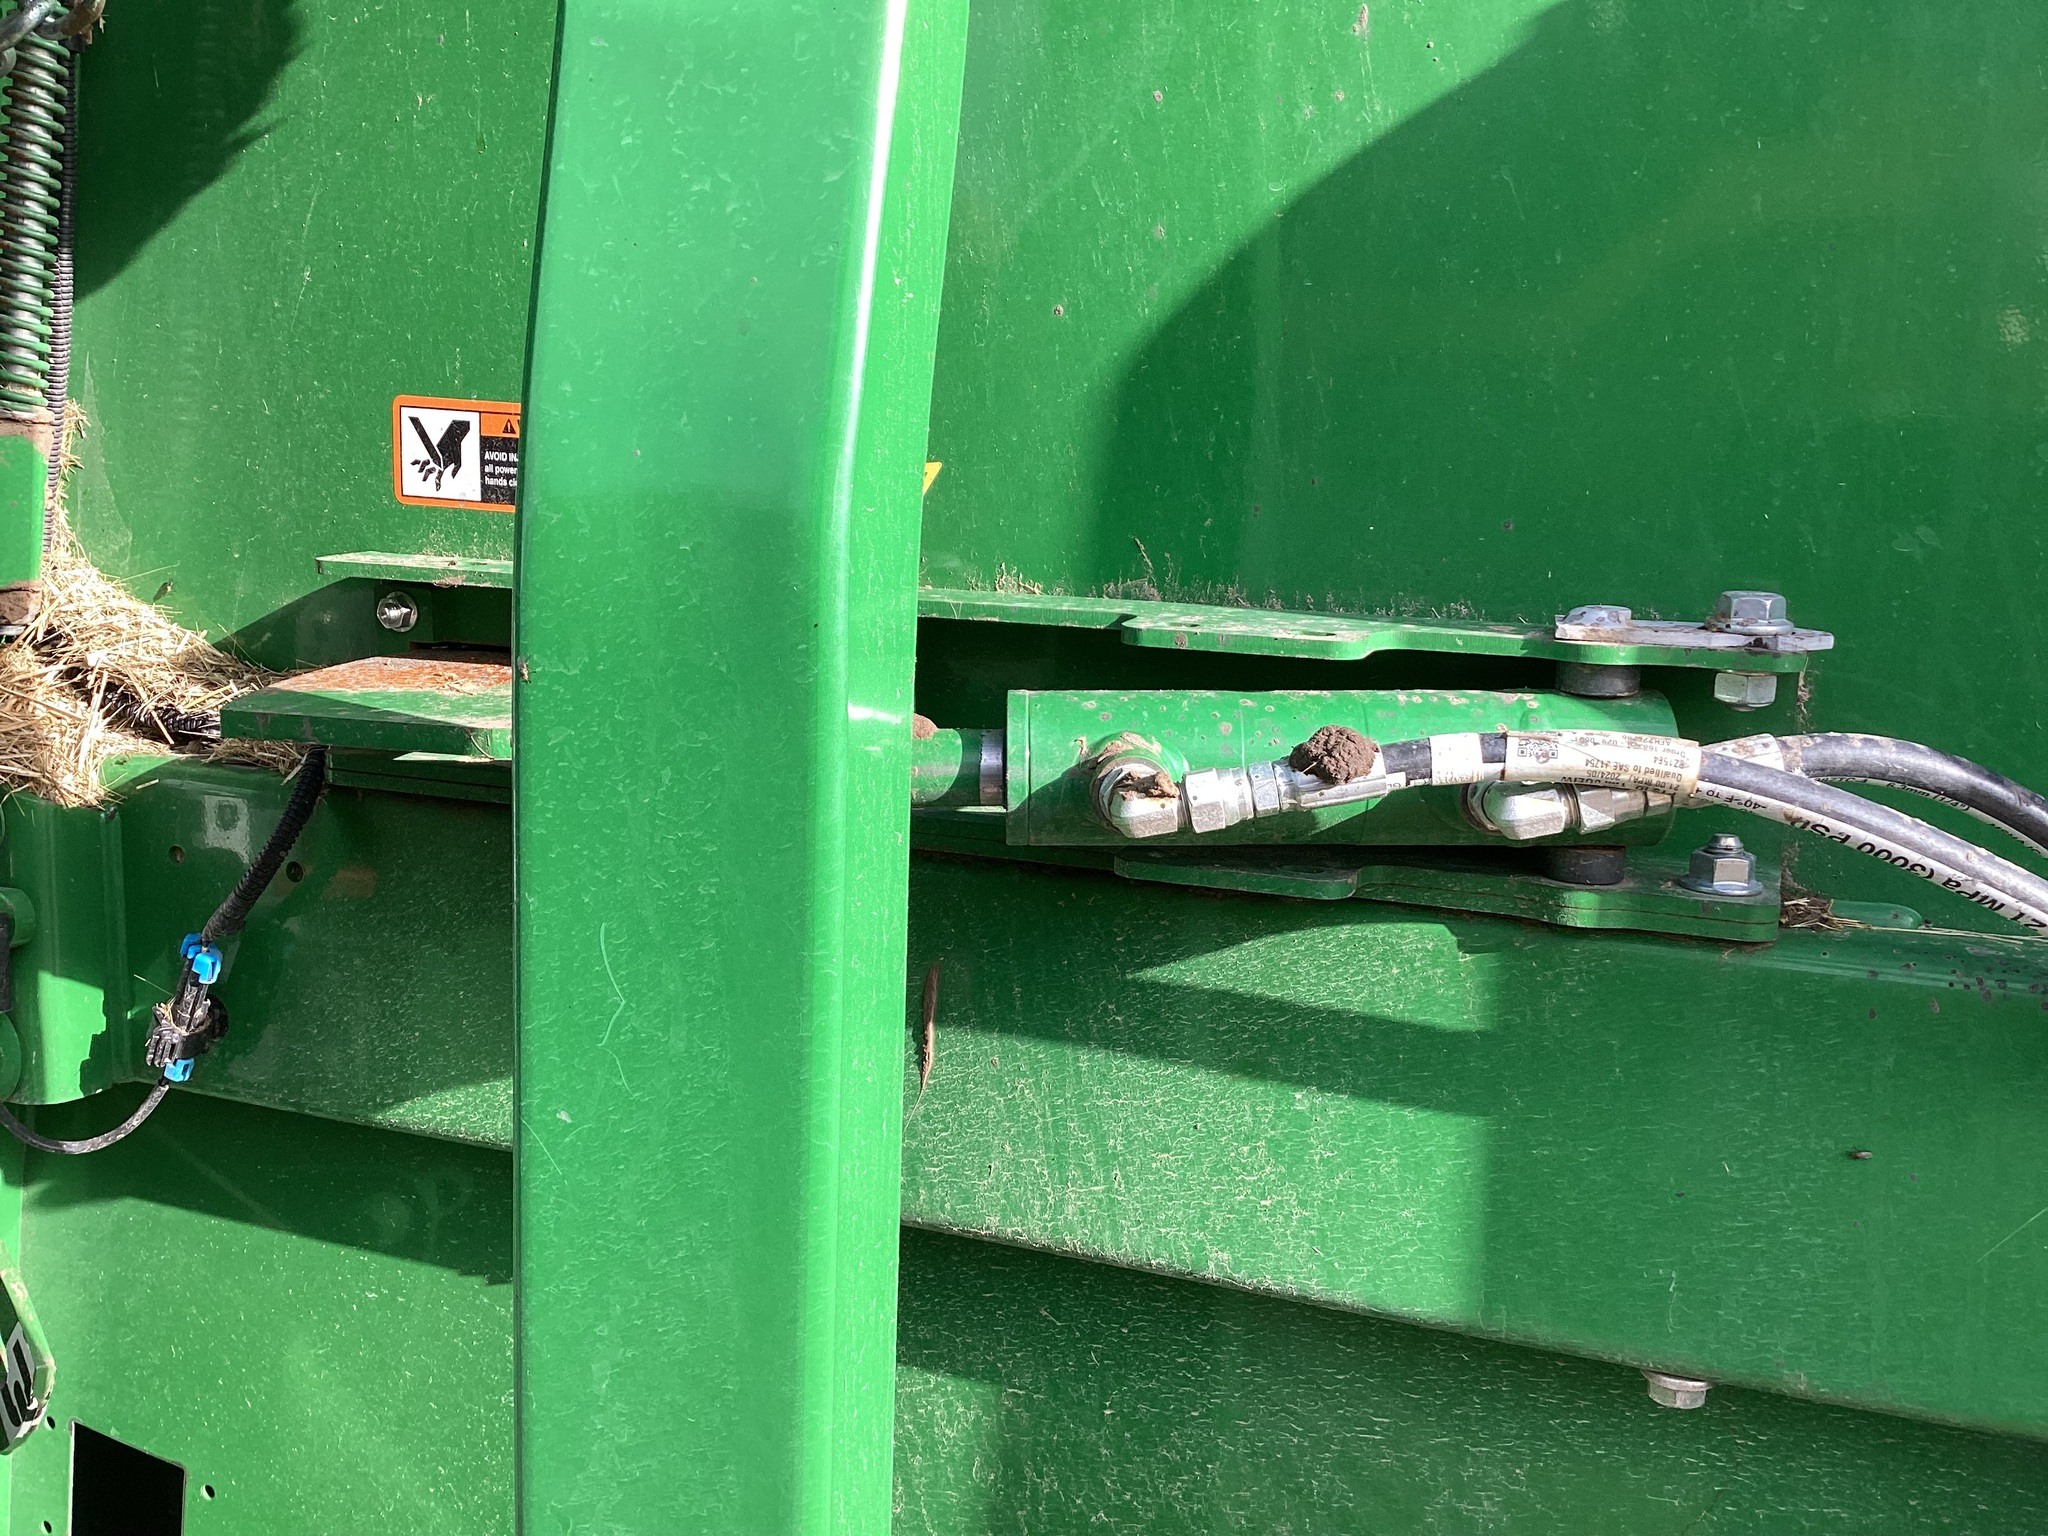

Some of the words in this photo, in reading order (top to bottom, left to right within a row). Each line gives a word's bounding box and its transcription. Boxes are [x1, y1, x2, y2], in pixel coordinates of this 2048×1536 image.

[484, 451, 507, 462] AVOID
[484, 464, 494, 473] all
[484, 476, 508, 486] hands
[1585, 758, 1611, 770] J1754
[1613, 762, 1630, 774] SAE
[1633, 764, 1642, 775] to
[1586, 769, 1621, 782] 2024/05
[1645, 766, 1683, 783] Qualified
[1706, 789, 1720, 799] TO
[1857, 842, 1935, 879] (3000
[1942, 877, 2006, 911] MPa
[2010, 912, 2048, 932] 21
